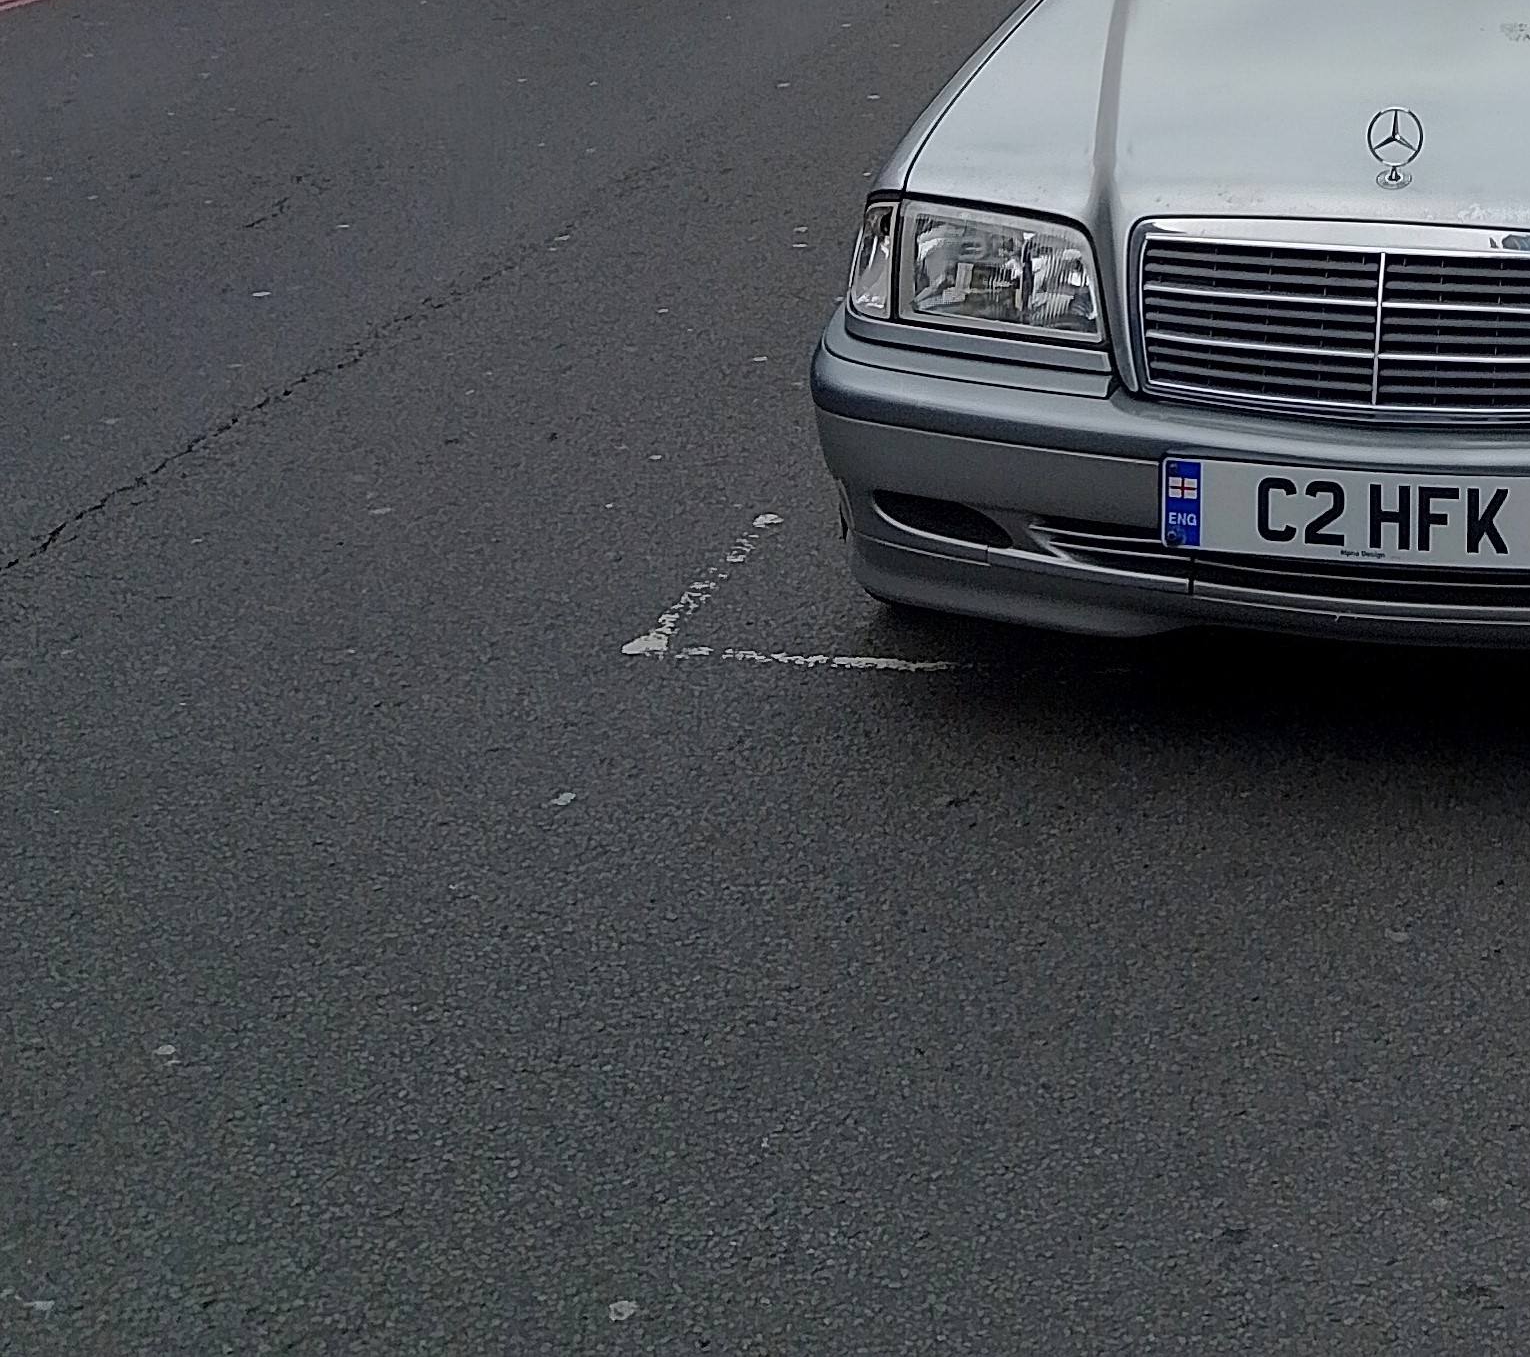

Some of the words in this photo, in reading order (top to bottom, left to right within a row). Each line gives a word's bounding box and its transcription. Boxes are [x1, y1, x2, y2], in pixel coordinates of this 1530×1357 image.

[1168, 512, 1197, 526] ENG
[1257, 476, 1346, 548] C2
[1368, 483, 1510, 555] HFK
